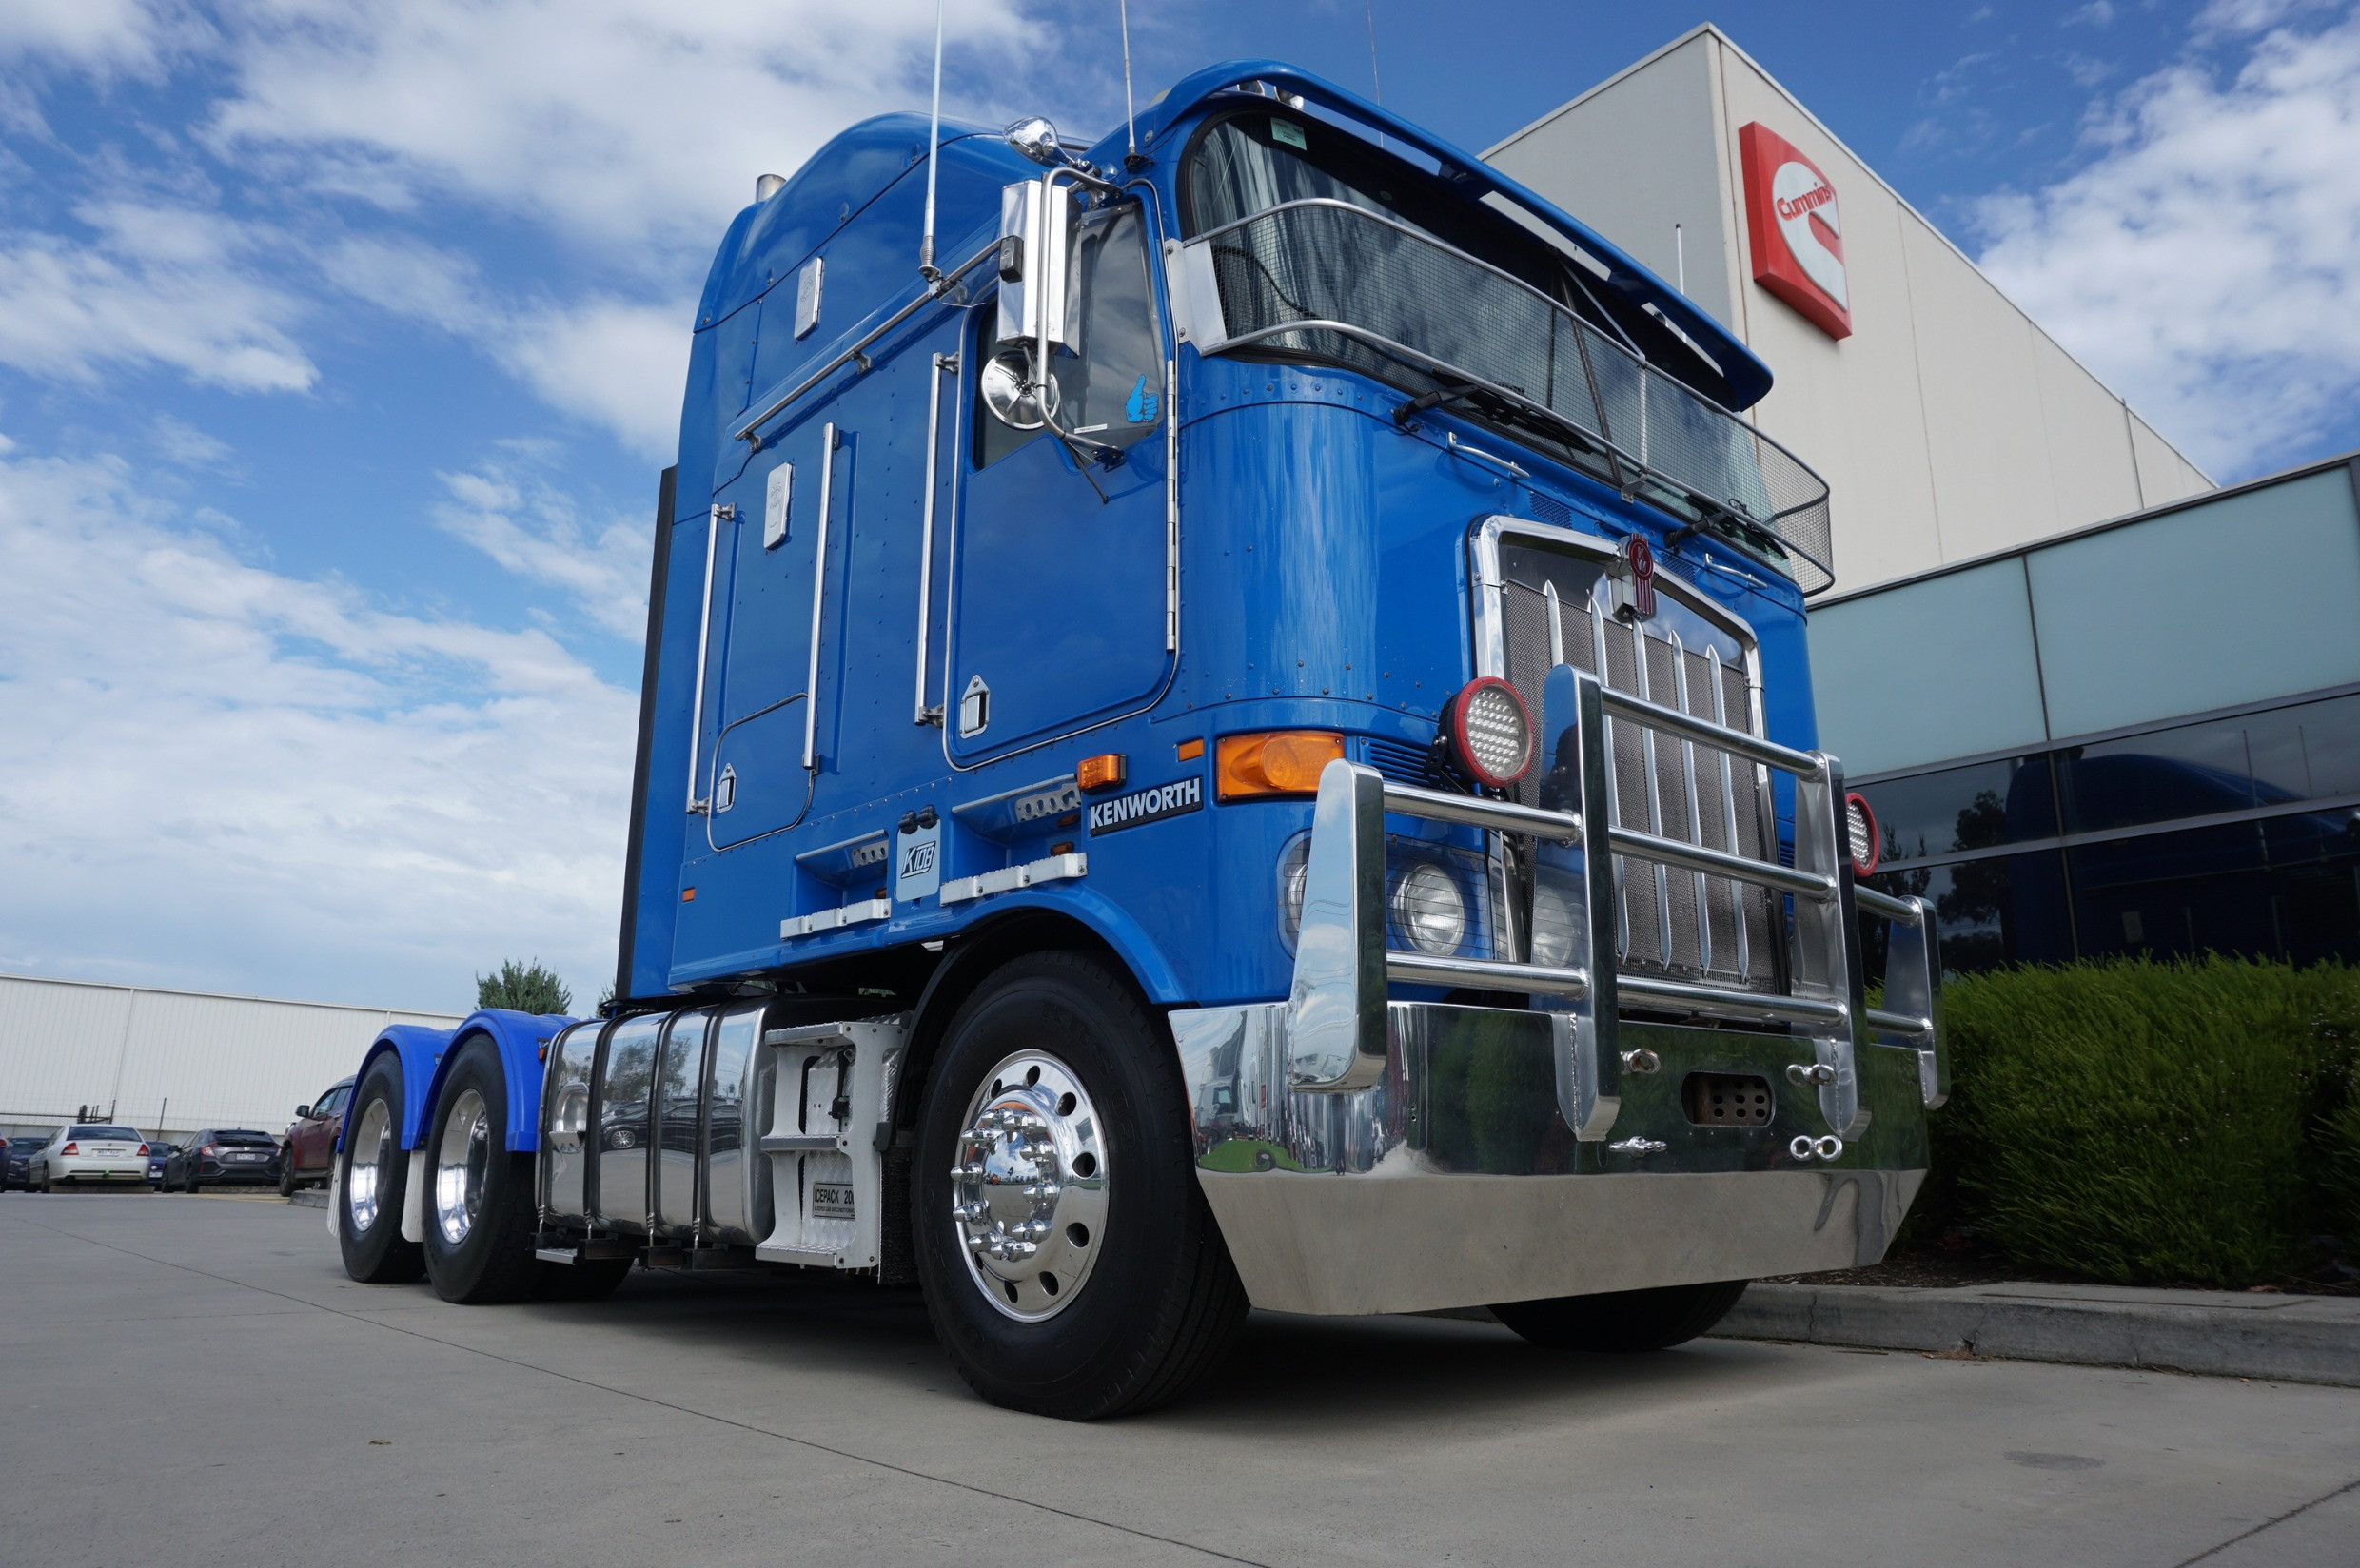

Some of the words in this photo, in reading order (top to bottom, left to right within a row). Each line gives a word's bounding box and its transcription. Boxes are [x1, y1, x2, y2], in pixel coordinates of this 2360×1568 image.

[1777, 183, 1832, 221] Cummins
[1091, 777, 1200, 829] KENWORTH
[901, 844, 934, 874] K108
[815, 1188, 839, 1204] ICEPACK
